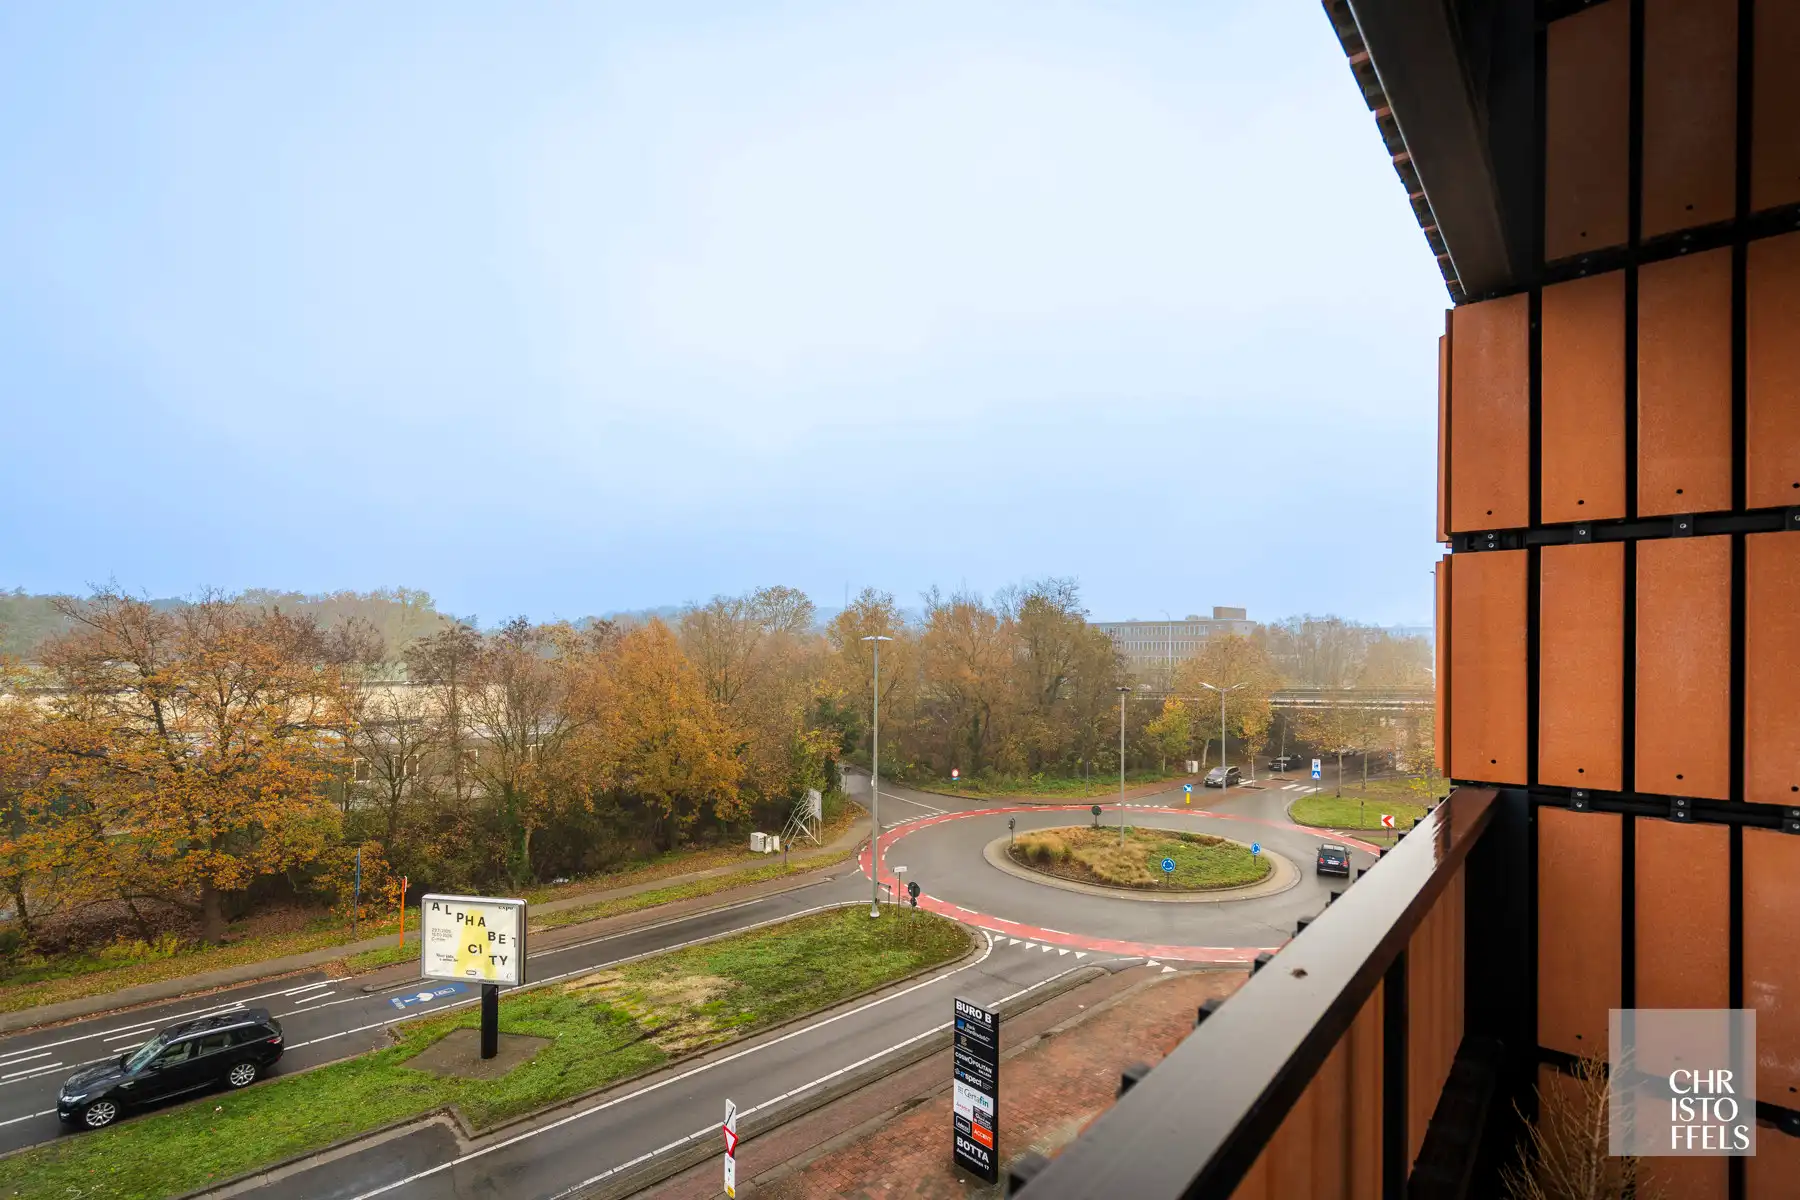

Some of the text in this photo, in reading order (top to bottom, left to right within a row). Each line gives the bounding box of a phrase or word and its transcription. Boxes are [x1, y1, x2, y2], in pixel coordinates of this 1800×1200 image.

[956, 1000, 982, 1019] BURO
[984, 1014, 992, 1024] B
[955, 1051, 992, 1075] COSMOPOLITAN
[964, 1088, 989, 1108] Certafin
[973, 1128, 992, 1144] ACCENT
[956, 1136, 990, 1164] BOTTA
